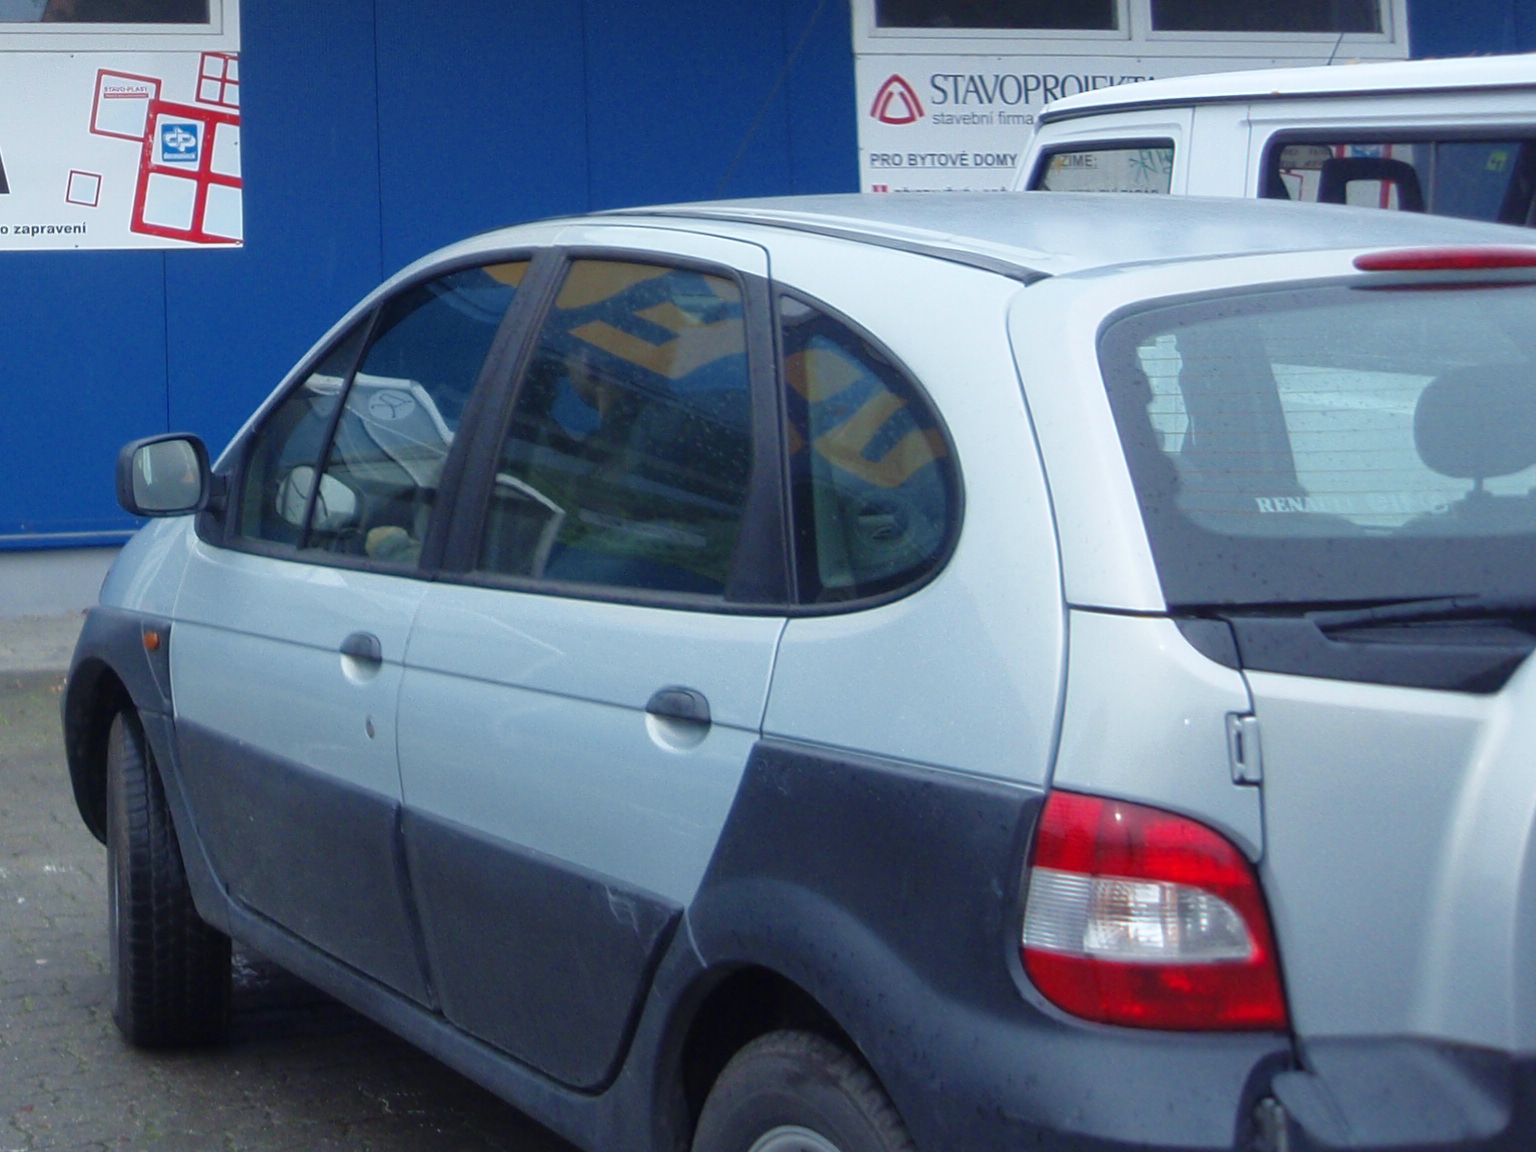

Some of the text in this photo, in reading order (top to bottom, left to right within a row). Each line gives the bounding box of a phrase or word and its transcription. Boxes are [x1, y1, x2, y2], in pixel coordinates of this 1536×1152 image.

[930, 73, 1156, 105] STAVOPRO
[932, 110, 1035, 125] stavební firma
[870, 153, 903, 167] PRO
[907, 150, 970, 167] BYTOVÉ
[973, 153, 1018, 167] DOMY
[13, 221, 87, 237] zapravení
